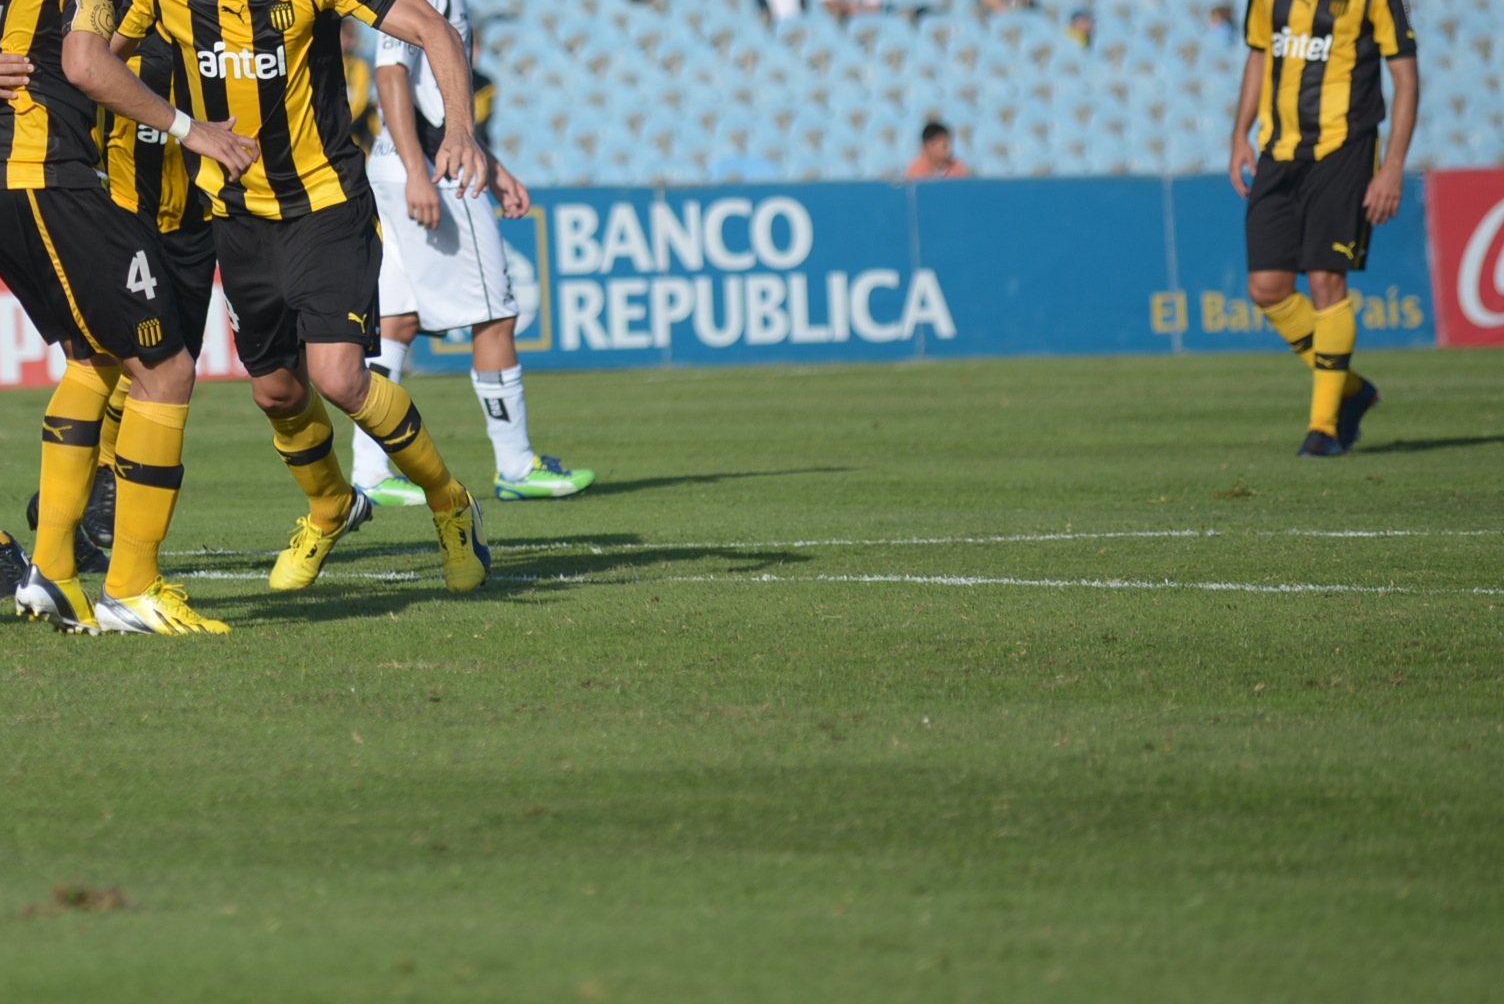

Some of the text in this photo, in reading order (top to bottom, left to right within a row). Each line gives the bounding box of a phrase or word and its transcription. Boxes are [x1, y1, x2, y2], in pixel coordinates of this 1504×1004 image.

[197, 42, 287, 80] antel
[1271, 26, 1333, 62] antel
[554, 196, 814, 277] BANCO
[126, 250, 157, 300] 4
[558, 268, 957, 351] REPUBLICA
[1150, 291, 1188, 334] El
